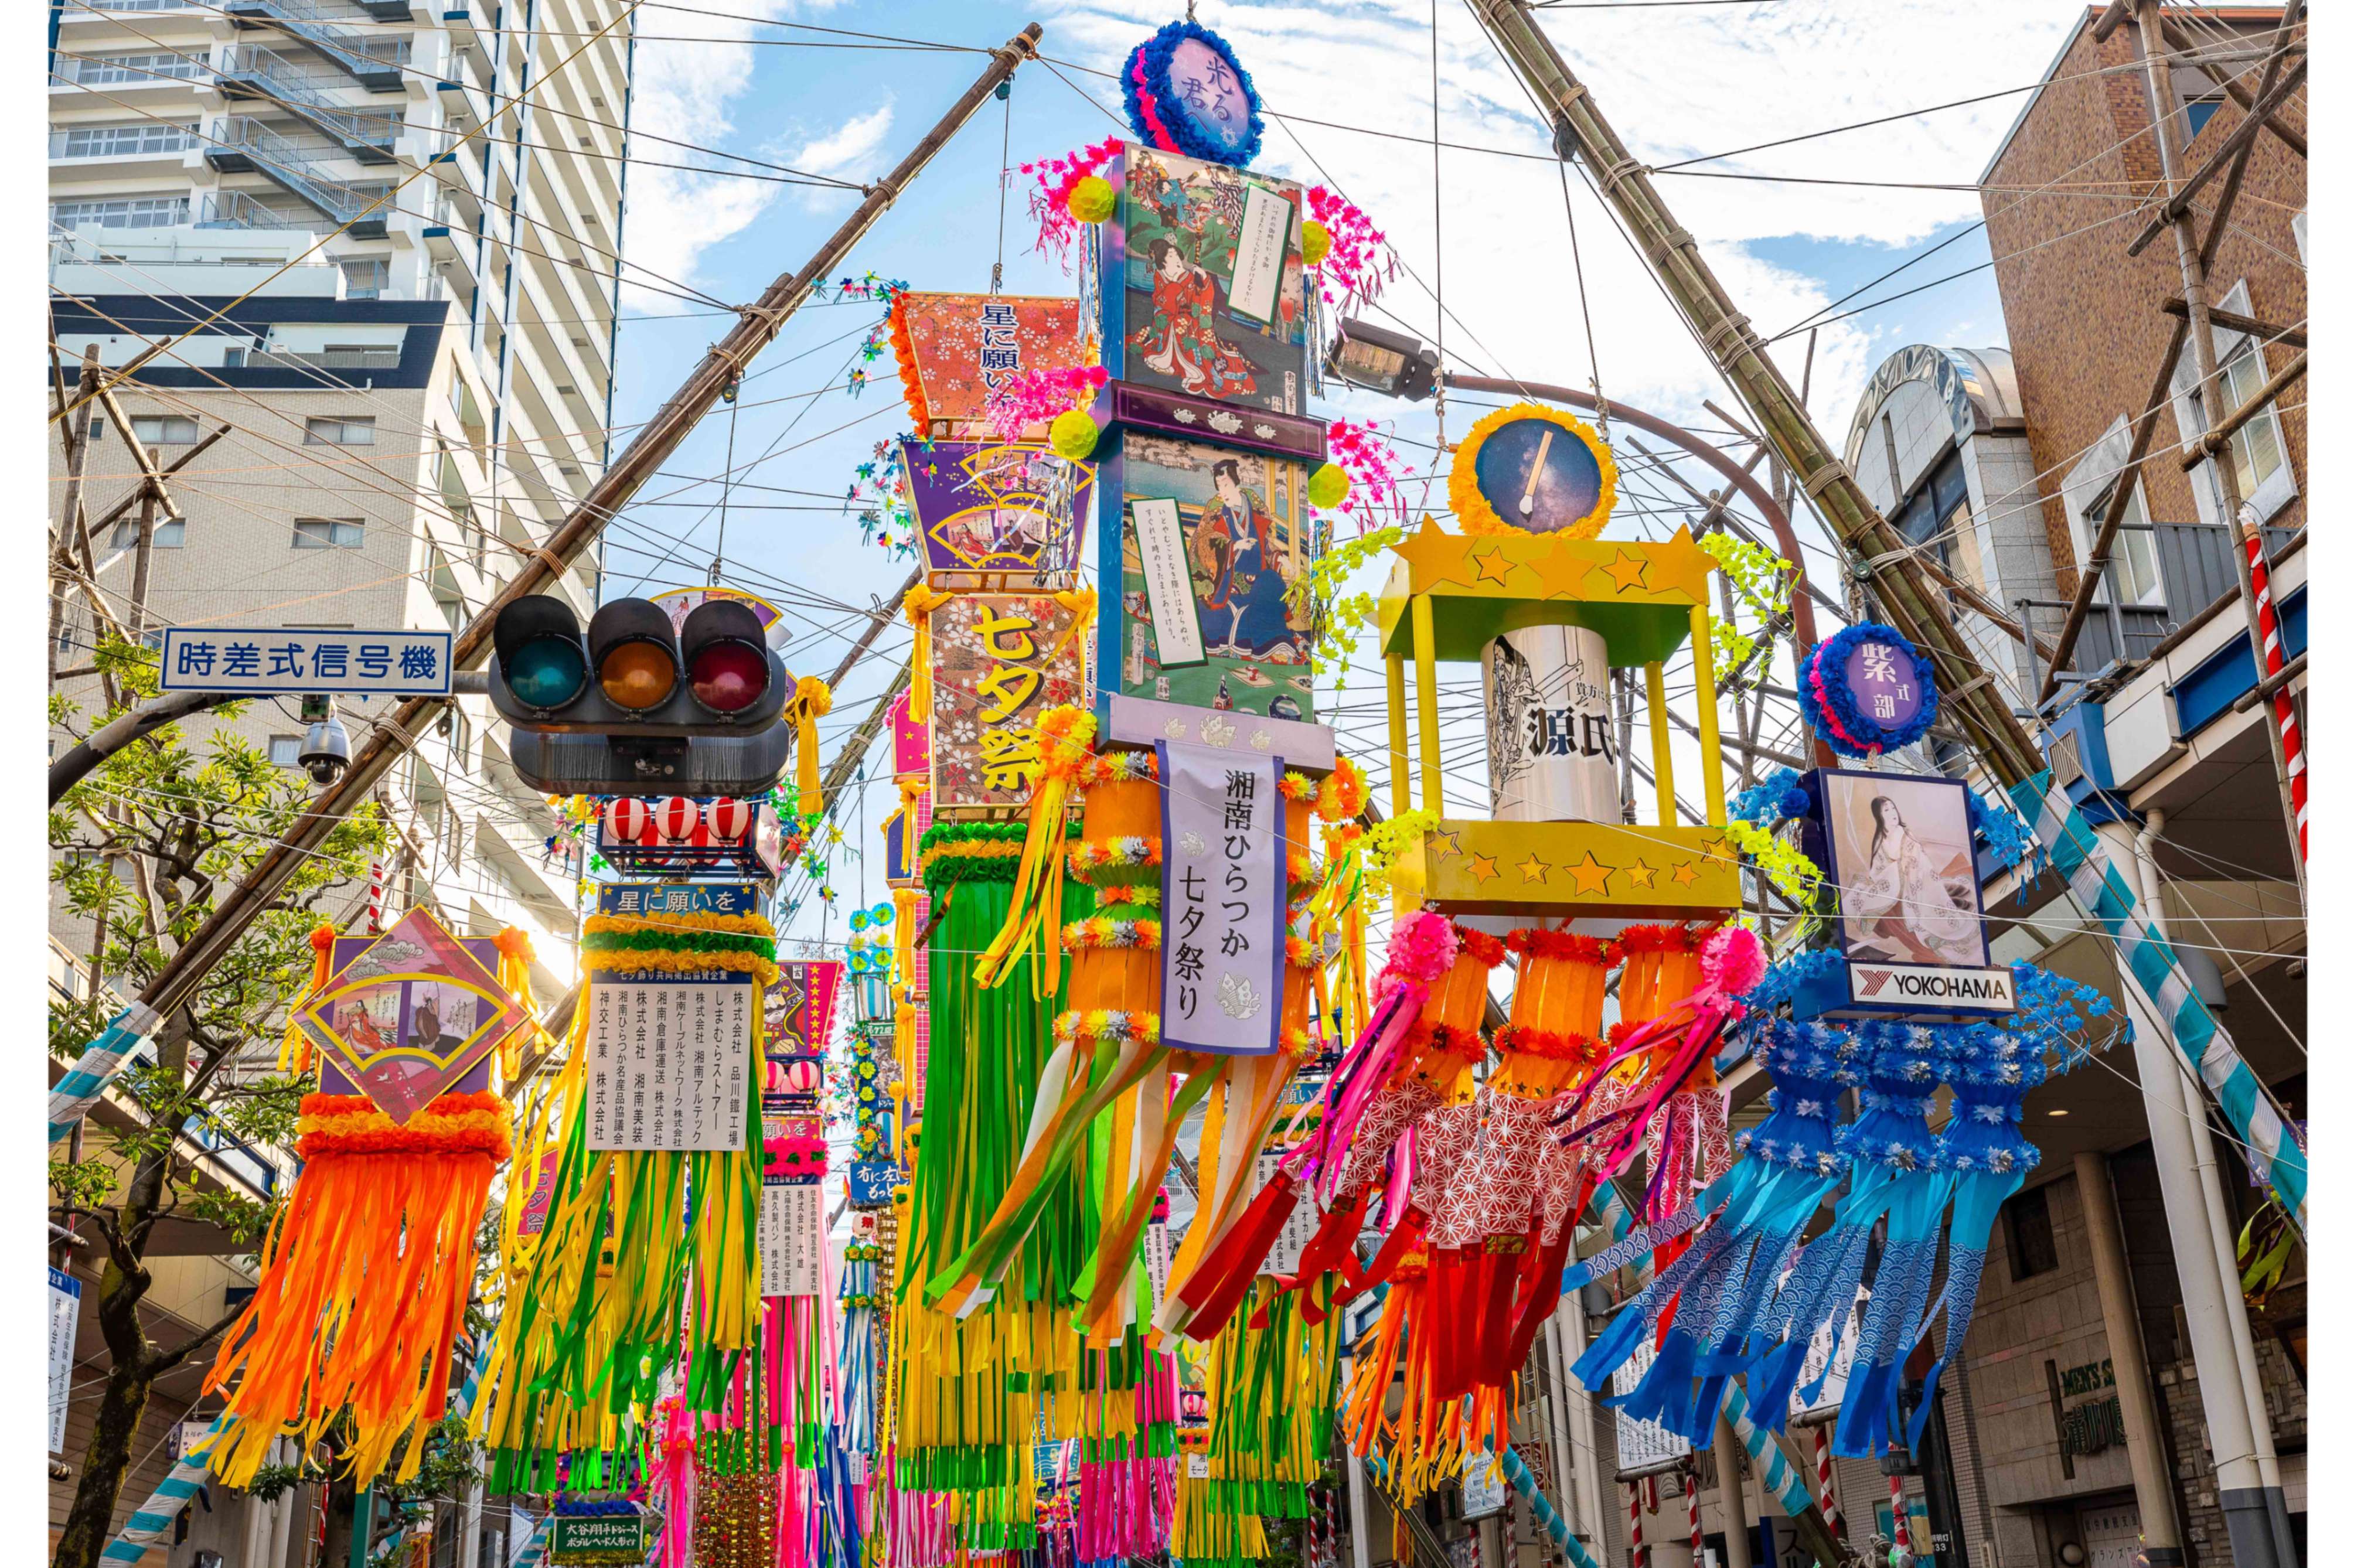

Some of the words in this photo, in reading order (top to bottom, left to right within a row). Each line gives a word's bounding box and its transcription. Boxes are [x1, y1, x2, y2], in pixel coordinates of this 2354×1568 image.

[1181, 77, 1210, 132] 君へ
[1206, 56, 1233, 121] 光る
[1145, 509, 1176, 640] すぐれて時めきたまふありけり。
[178, 642, 437, 680] 時差式信号機
[1576, 681, 1611, 705] 貴方に
[970, 604, 1045, 792] 七夕祭
[1527, 704, 1614, 766] 源氏
[1221, 769, 1255, 957] 湘南ひらつか
[618, 891, 735, 912] 星に願いを
[1174, 865, 1207, 1021] 七夕祭り
[695, 991, 705, 1044] 株式会社
[1894, 974, 2008, 1000] YOKOHAMA
[597, 990, 610, 1059] 神交工業
[635, 990, 647, 1060] 株式会社
[655, 990, 667, 1084] 湘南倉庫運送
[674, 990, 686, 1107] 湘南ケーブルネットワーク
[731, 990, 744, 1054] 株式会社
[613, 990, 628, 1145] 湘南ひらつか名産品協議会
[711, 990, 724, 1130] しまむらストアー
[594, 1071, 607, 1141] 株式会社
[632, 1072, 645, 1144] 湘南美装
[653, 1090, 665, 1147] 株式会社
[673, 1109, 683, 1147] 株式会社
[692, 1050, 704, 1144] 湘南アルテック
